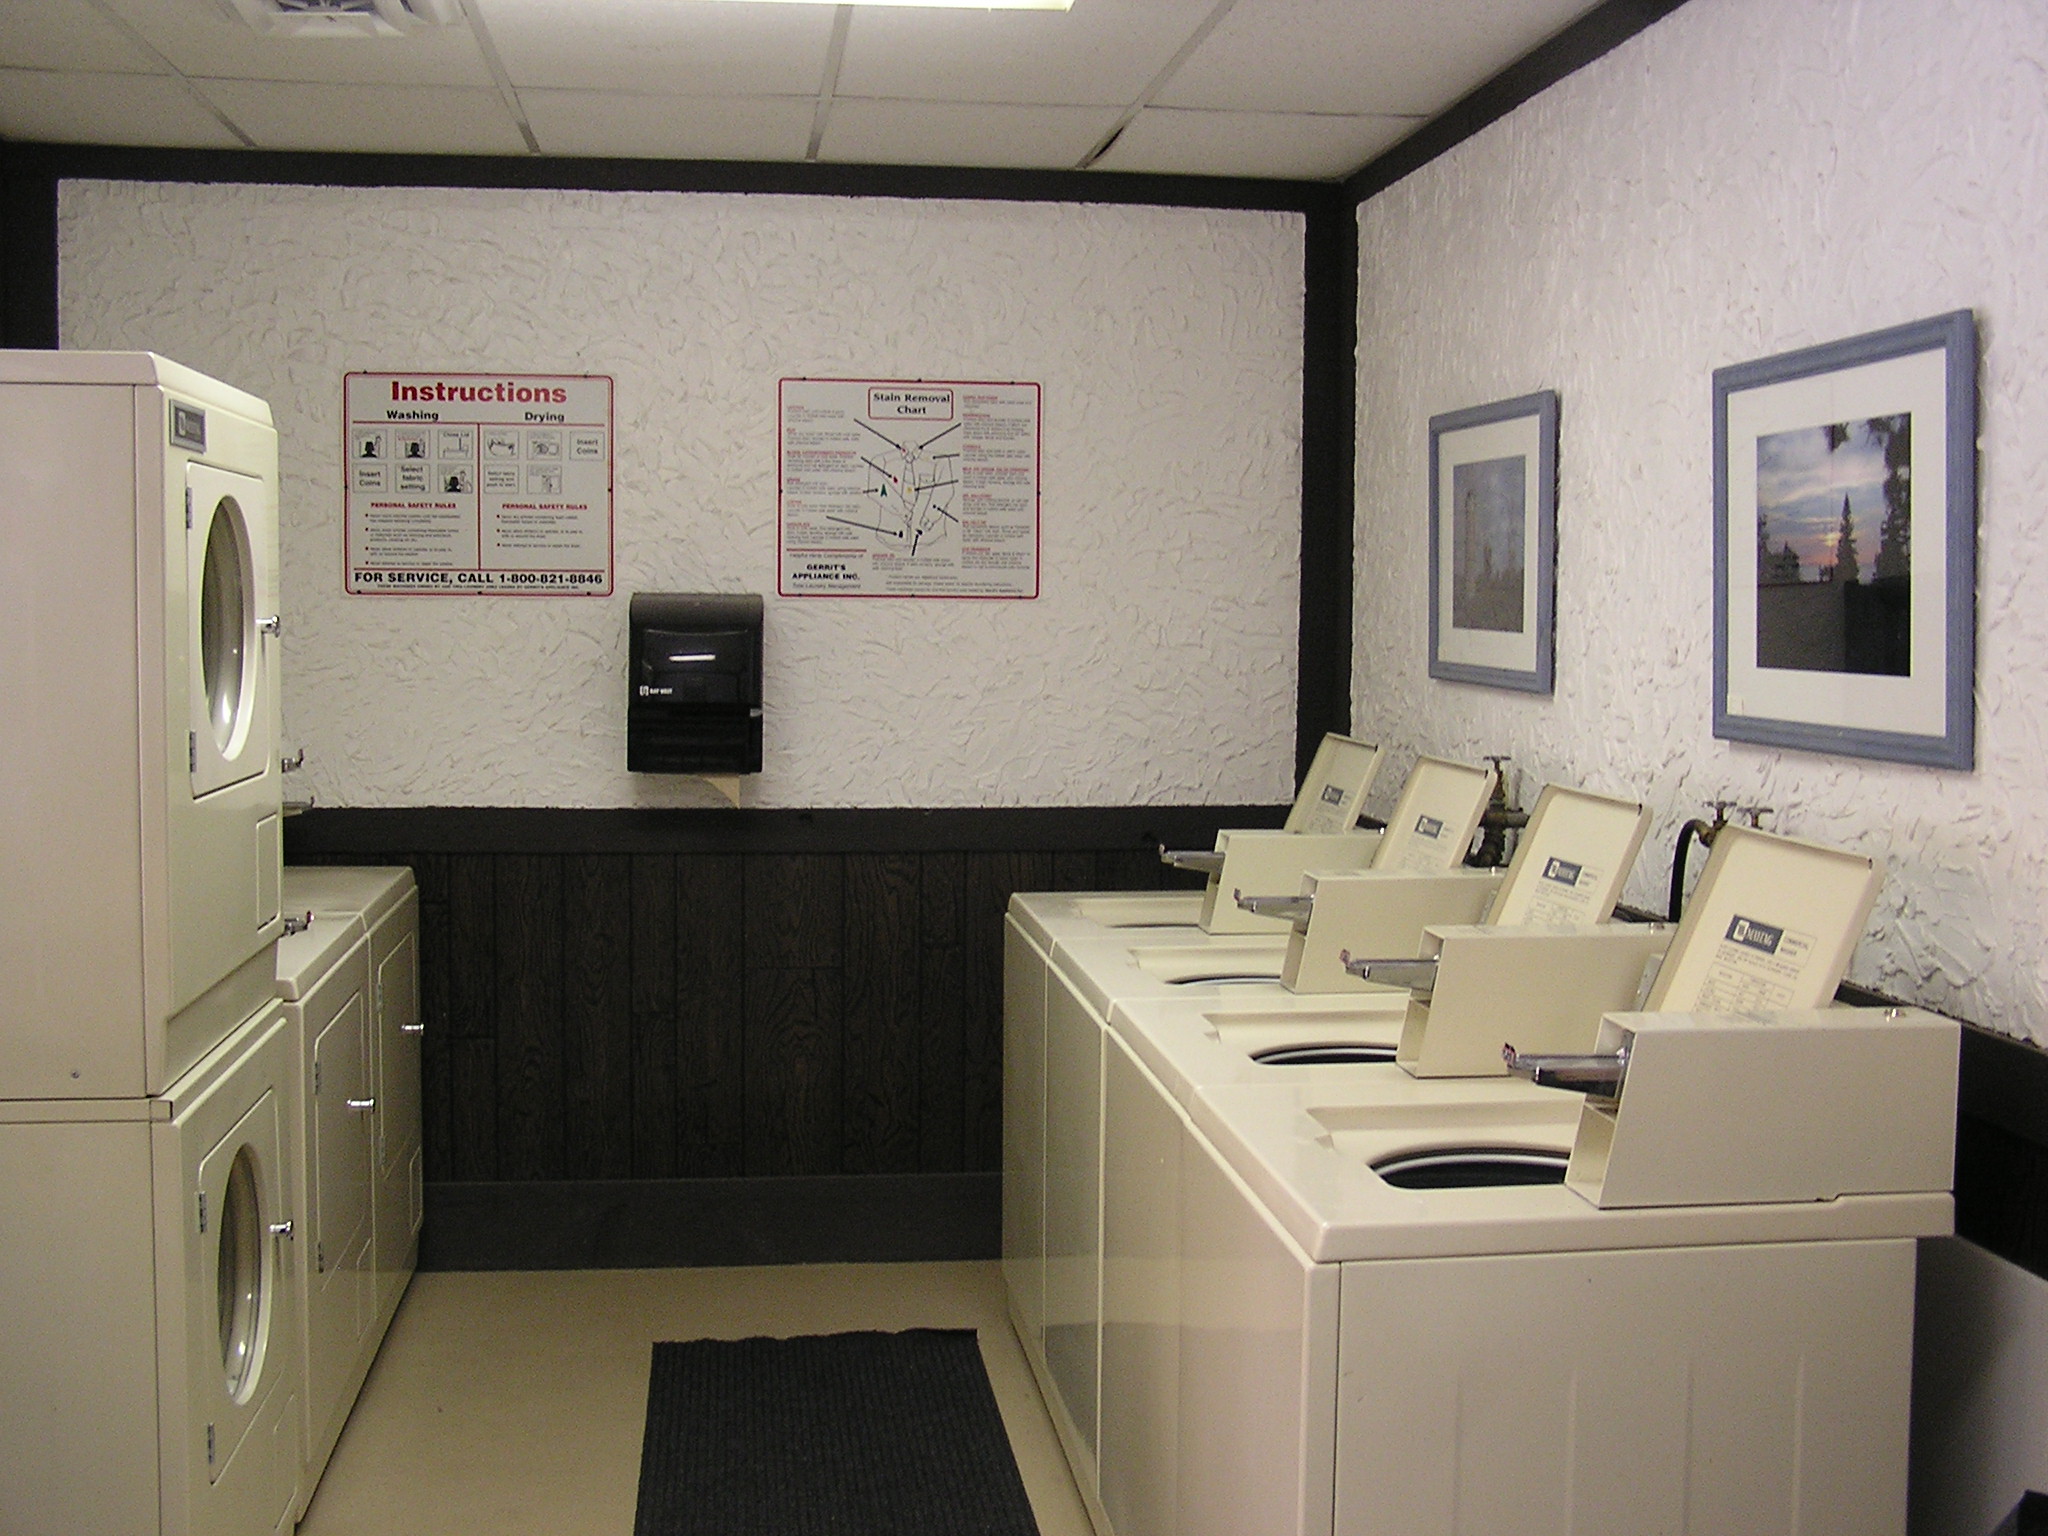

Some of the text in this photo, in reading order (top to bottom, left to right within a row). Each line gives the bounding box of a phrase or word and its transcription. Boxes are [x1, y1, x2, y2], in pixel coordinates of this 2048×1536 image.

[391, 380, 568, 404] Instructions
[873, 392, 950, 403] Stain Removal
[896, 405, 927, 415] Chart
[386, 410, 440, 422] Washing
[524, 411, 566, 423] Drying
[359, 470, 381, 478] Insert
[359, 479, 381, 487] Coins
[400, 483, 426, 492] setting
[806, 563, 846, 571] GERRIT'S
[354, 572, 603, 585] FOR SERVICE, CALL 1-800-821-8846
[792, 572, 861, 581] APPLIANCE INC.
